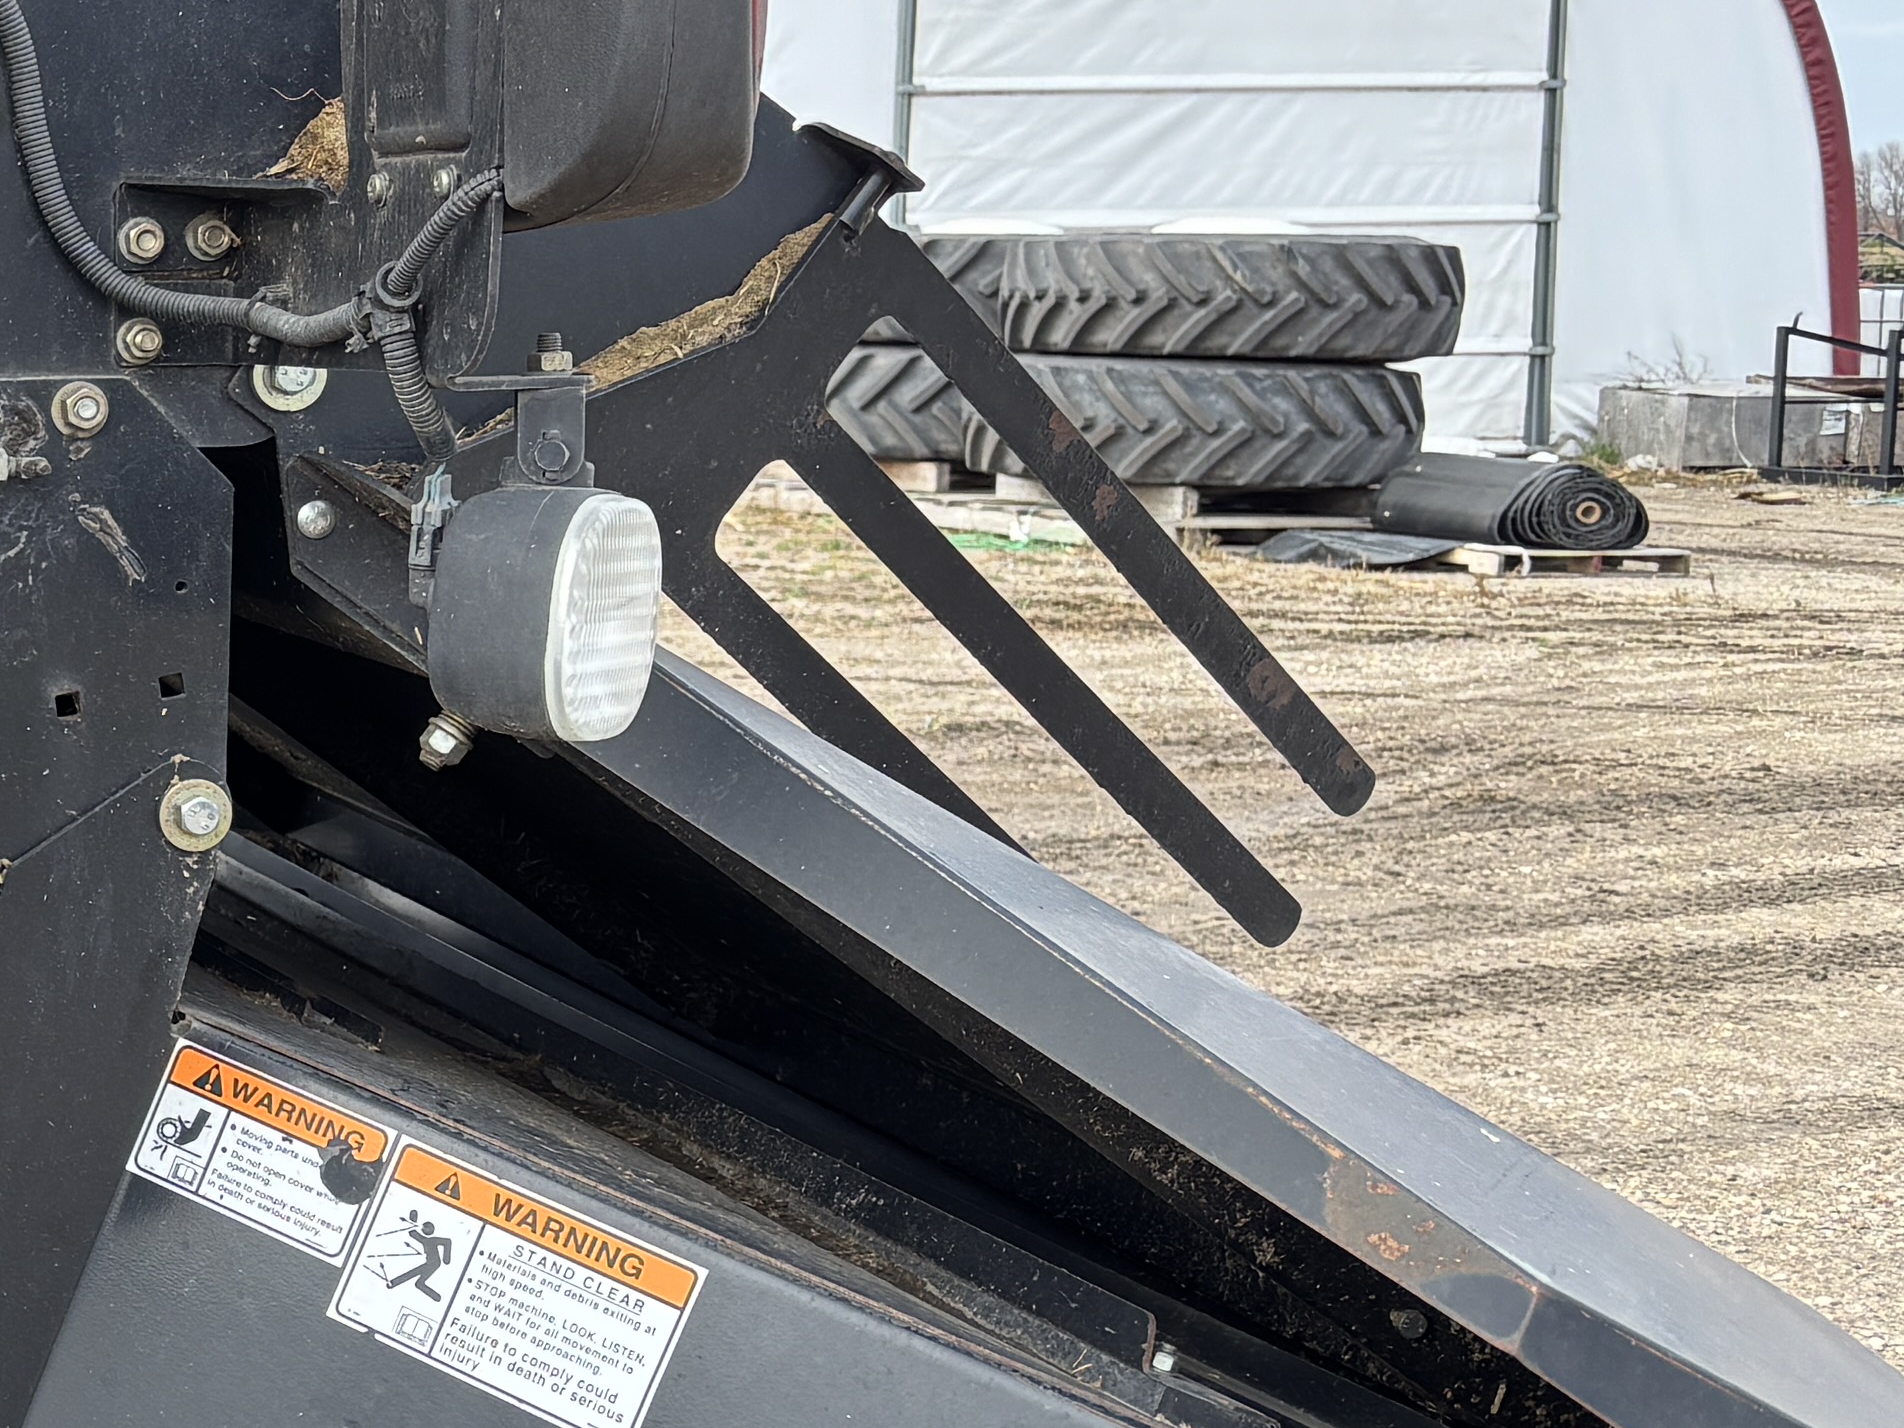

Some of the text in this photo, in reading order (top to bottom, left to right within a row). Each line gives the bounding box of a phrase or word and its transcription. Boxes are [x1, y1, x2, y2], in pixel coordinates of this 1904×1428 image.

[232, 1077, 364, 1152] WARNING
[239, 1125, 322, 1169] Moving parts und
[206, 1177, 216, 1188] in
[217, 1183, 244, 1201] death
[244, 1196, 255, 1205] or
[256, 1202, 291, 1222] serious
[210, 1167, 343, 1234] Failure to comply could result
[229, 1149, 244, 1162] Do
[244, 1157, 262, 1169] not
[262, 1165, 286, 1181] open
[286, 1176, 314, 1193] cover
[492, 1193, 644, 1279] WARNING
[473, 1278, 506, 1299] STOP
[480, 1263, 544, 1300] high speed.
[486, 1250, 656, 1336] Materials and debris exiting at
[512, 1243, 645, 1313] STAND CLEAR
[463, 1305, 489, 1322] stop
[490, 1315, 528, 1340] before
[468, 1293, 634, 1375] and WAIT for all movement to
[438, 1341, 480, 1372] injury
[443, 1332, 624, 1423] result in death or serious
[449, 1316, 619, 1404] Failure to comply could
